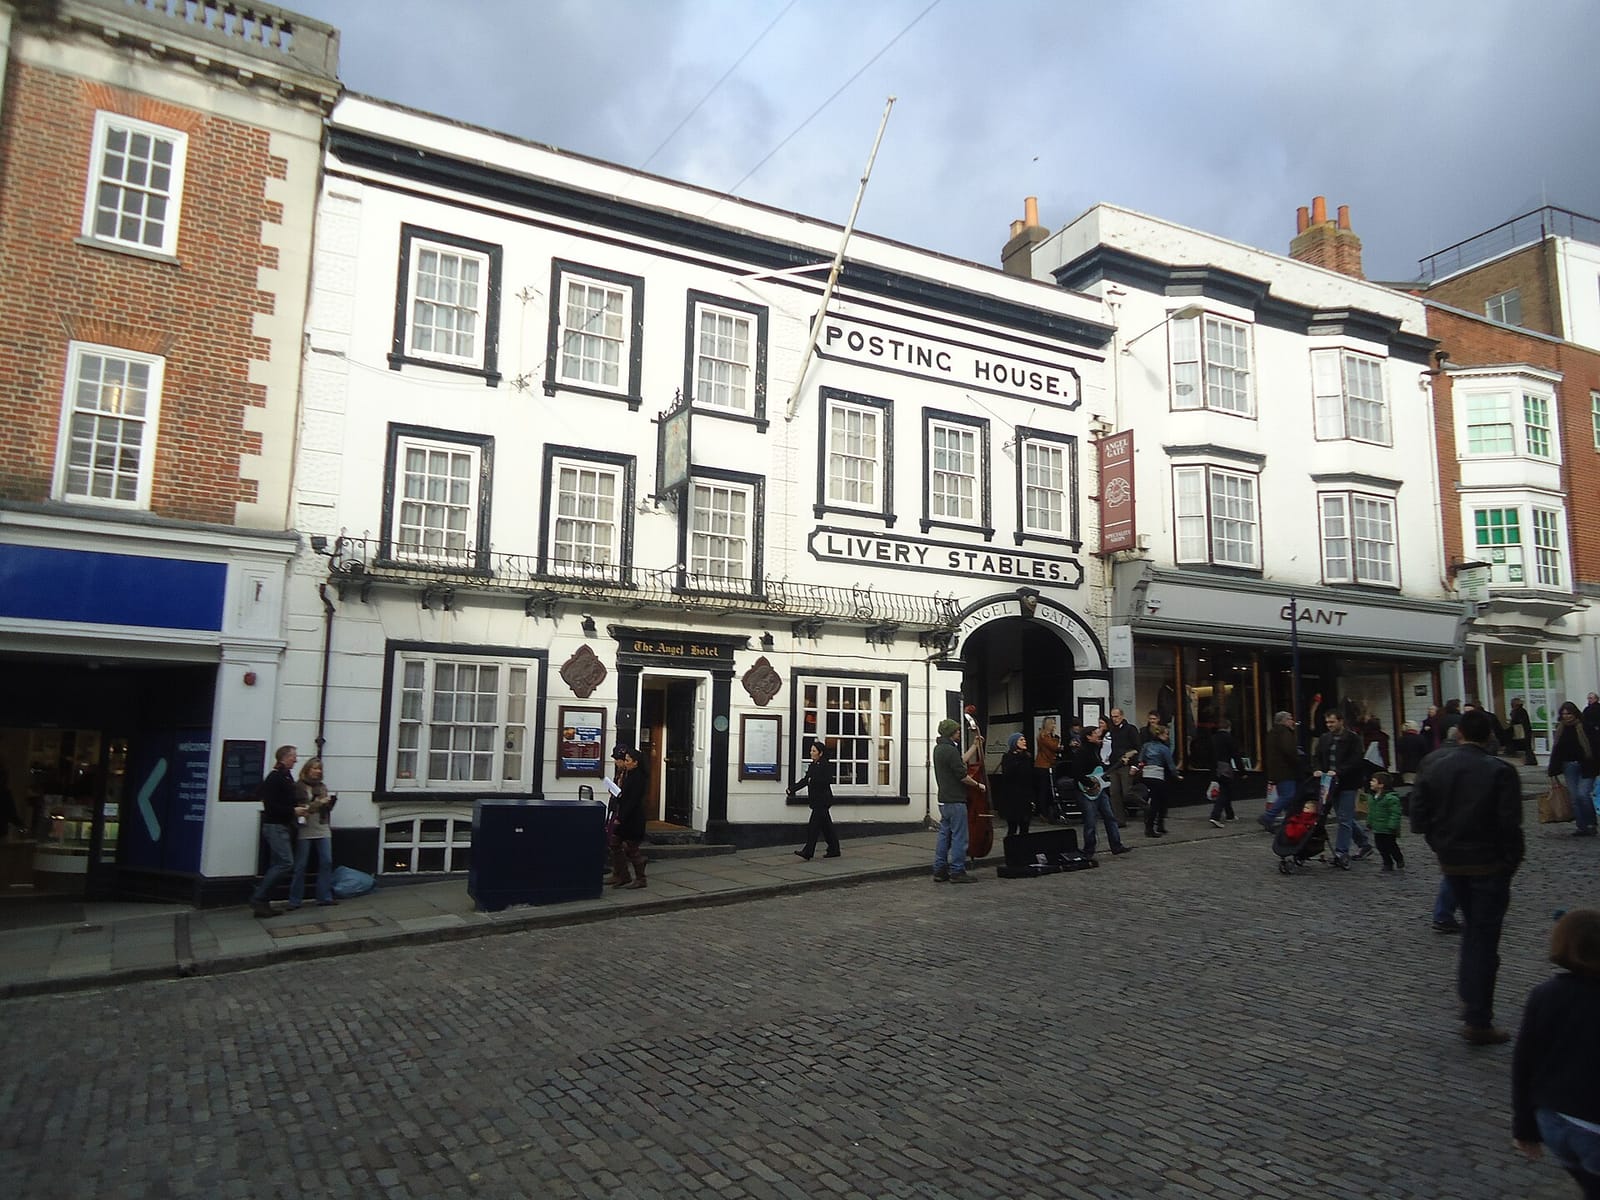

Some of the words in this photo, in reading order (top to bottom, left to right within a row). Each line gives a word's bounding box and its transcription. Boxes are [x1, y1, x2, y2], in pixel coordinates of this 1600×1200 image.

[826, 325, 951, 372] POSTING
[975, 360, 1068, 397] HOUSE.
[827, 535, 929, 565] LIVERY
[948, 551, 1068, 581] STABLES.
[963, 603, 1012, 634] ANGEL
[1041, 606, 1077, 633] GATE
[1280, 605, 1348, 626] GANT
[634, 640, 654, 652] The
[656, 642, 684, 656] Angel
[690, 644, 719, 657] Hotel
